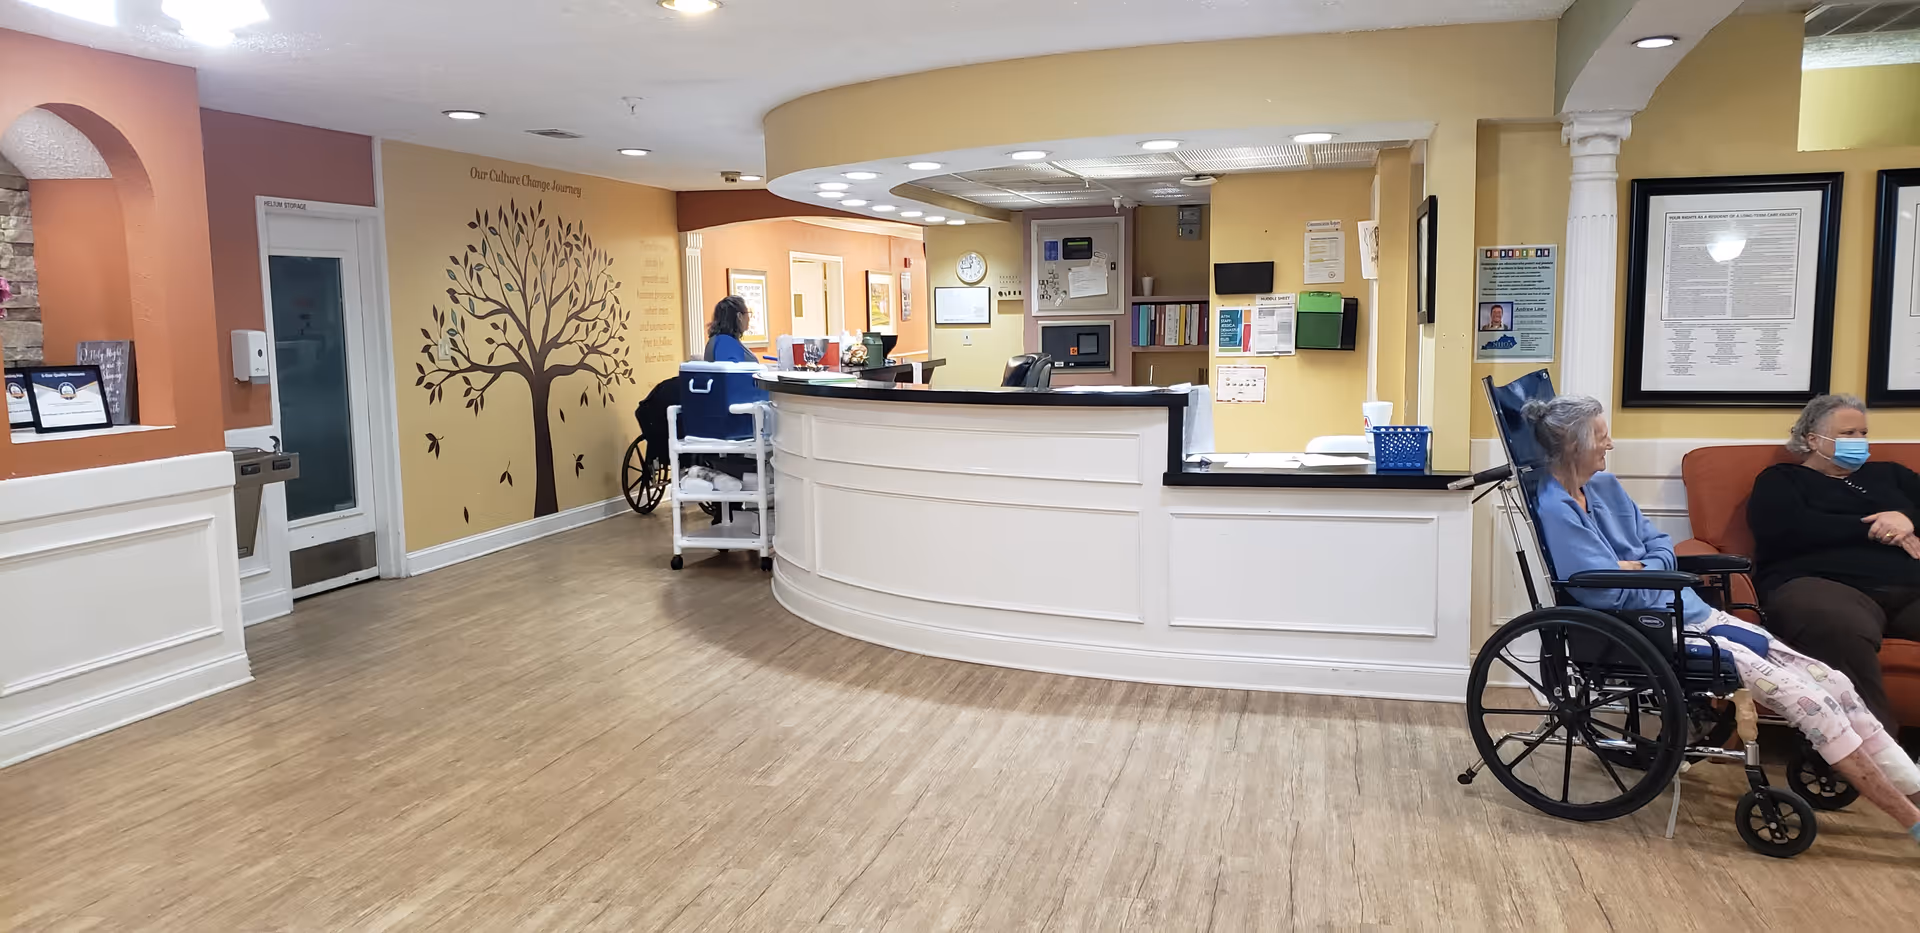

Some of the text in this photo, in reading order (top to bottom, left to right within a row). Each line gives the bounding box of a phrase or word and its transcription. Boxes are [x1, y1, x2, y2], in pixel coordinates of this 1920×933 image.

[470, 166, 582, 199] Our Culture Change Journey
[284, 202, 306, 210] STORAGE
[1485, 249, 1550, 258] OMBUDSMAN
